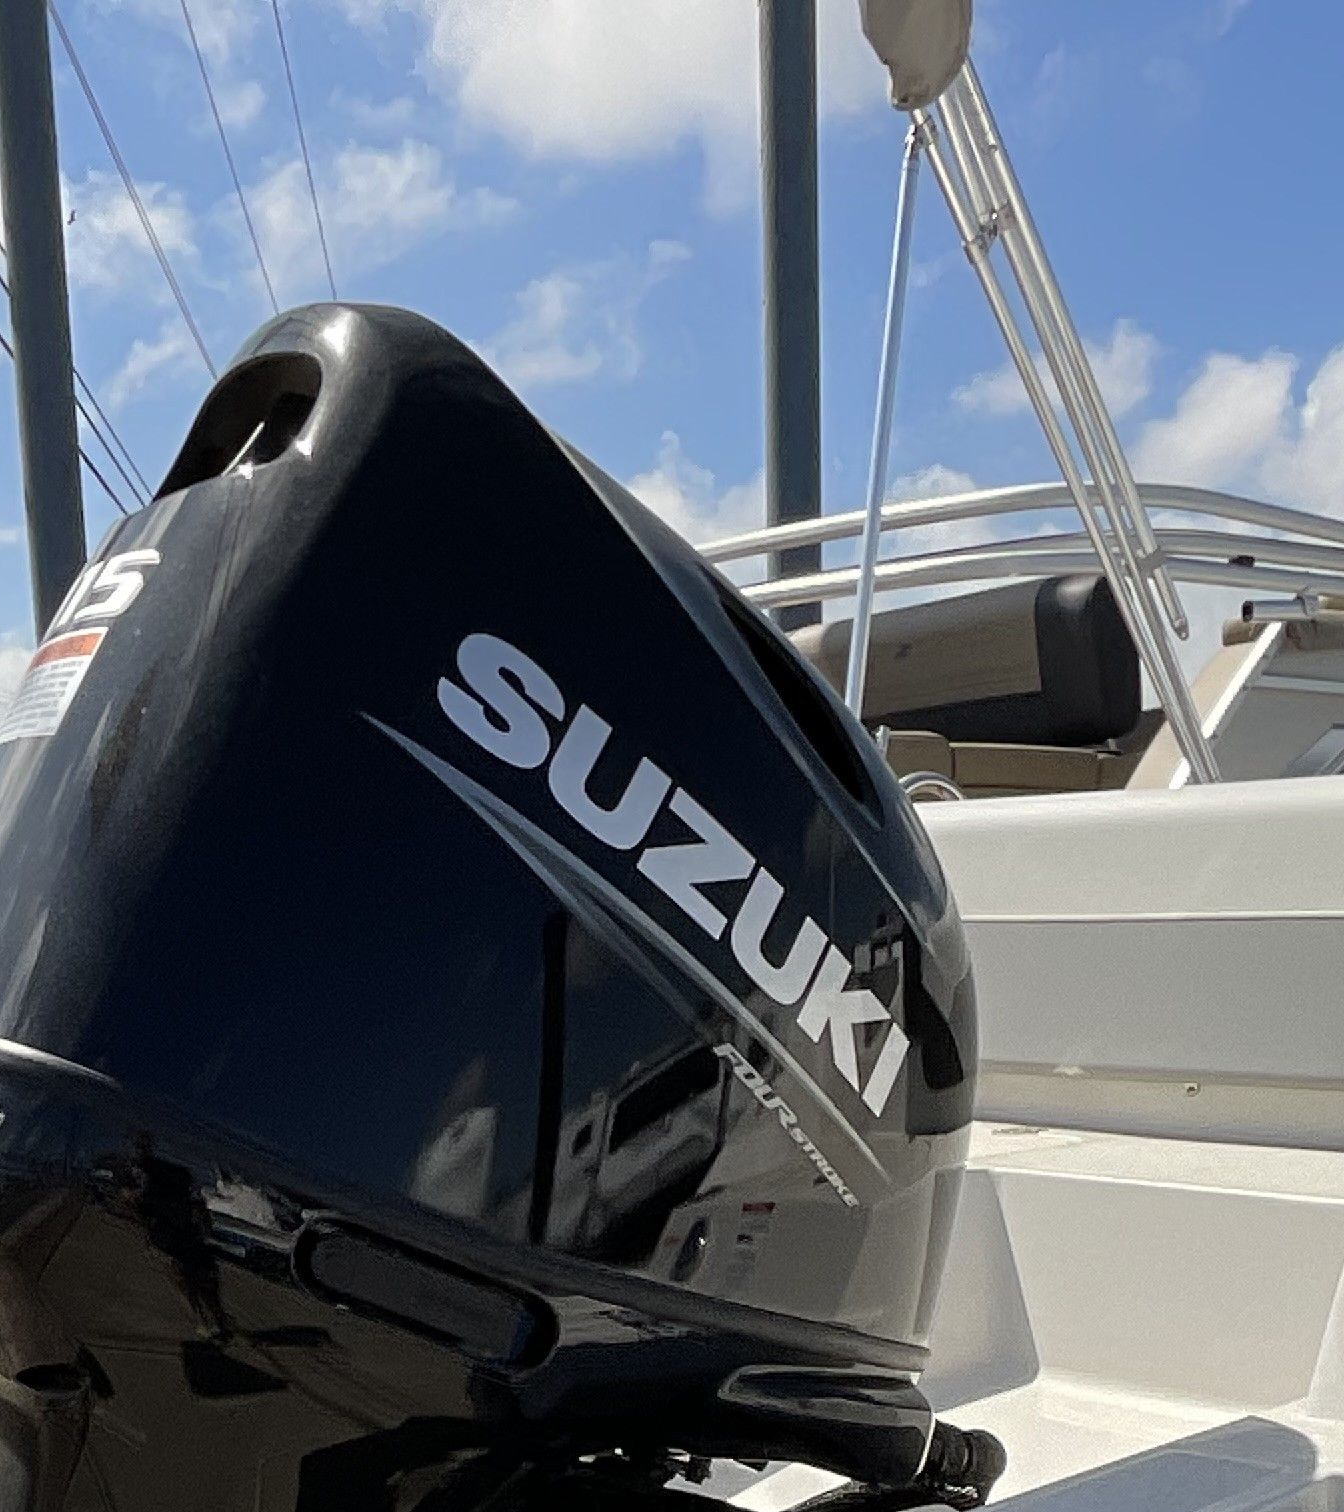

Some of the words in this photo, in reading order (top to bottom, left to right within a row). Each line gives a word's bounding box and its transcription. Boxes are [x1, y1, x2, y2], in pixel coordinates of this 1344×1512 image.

[437, 633, 910, 1118] SUZUKI
[713, 1042, 798, 1131] FOUR
[789, 1126, 861, 1207] STROKE
